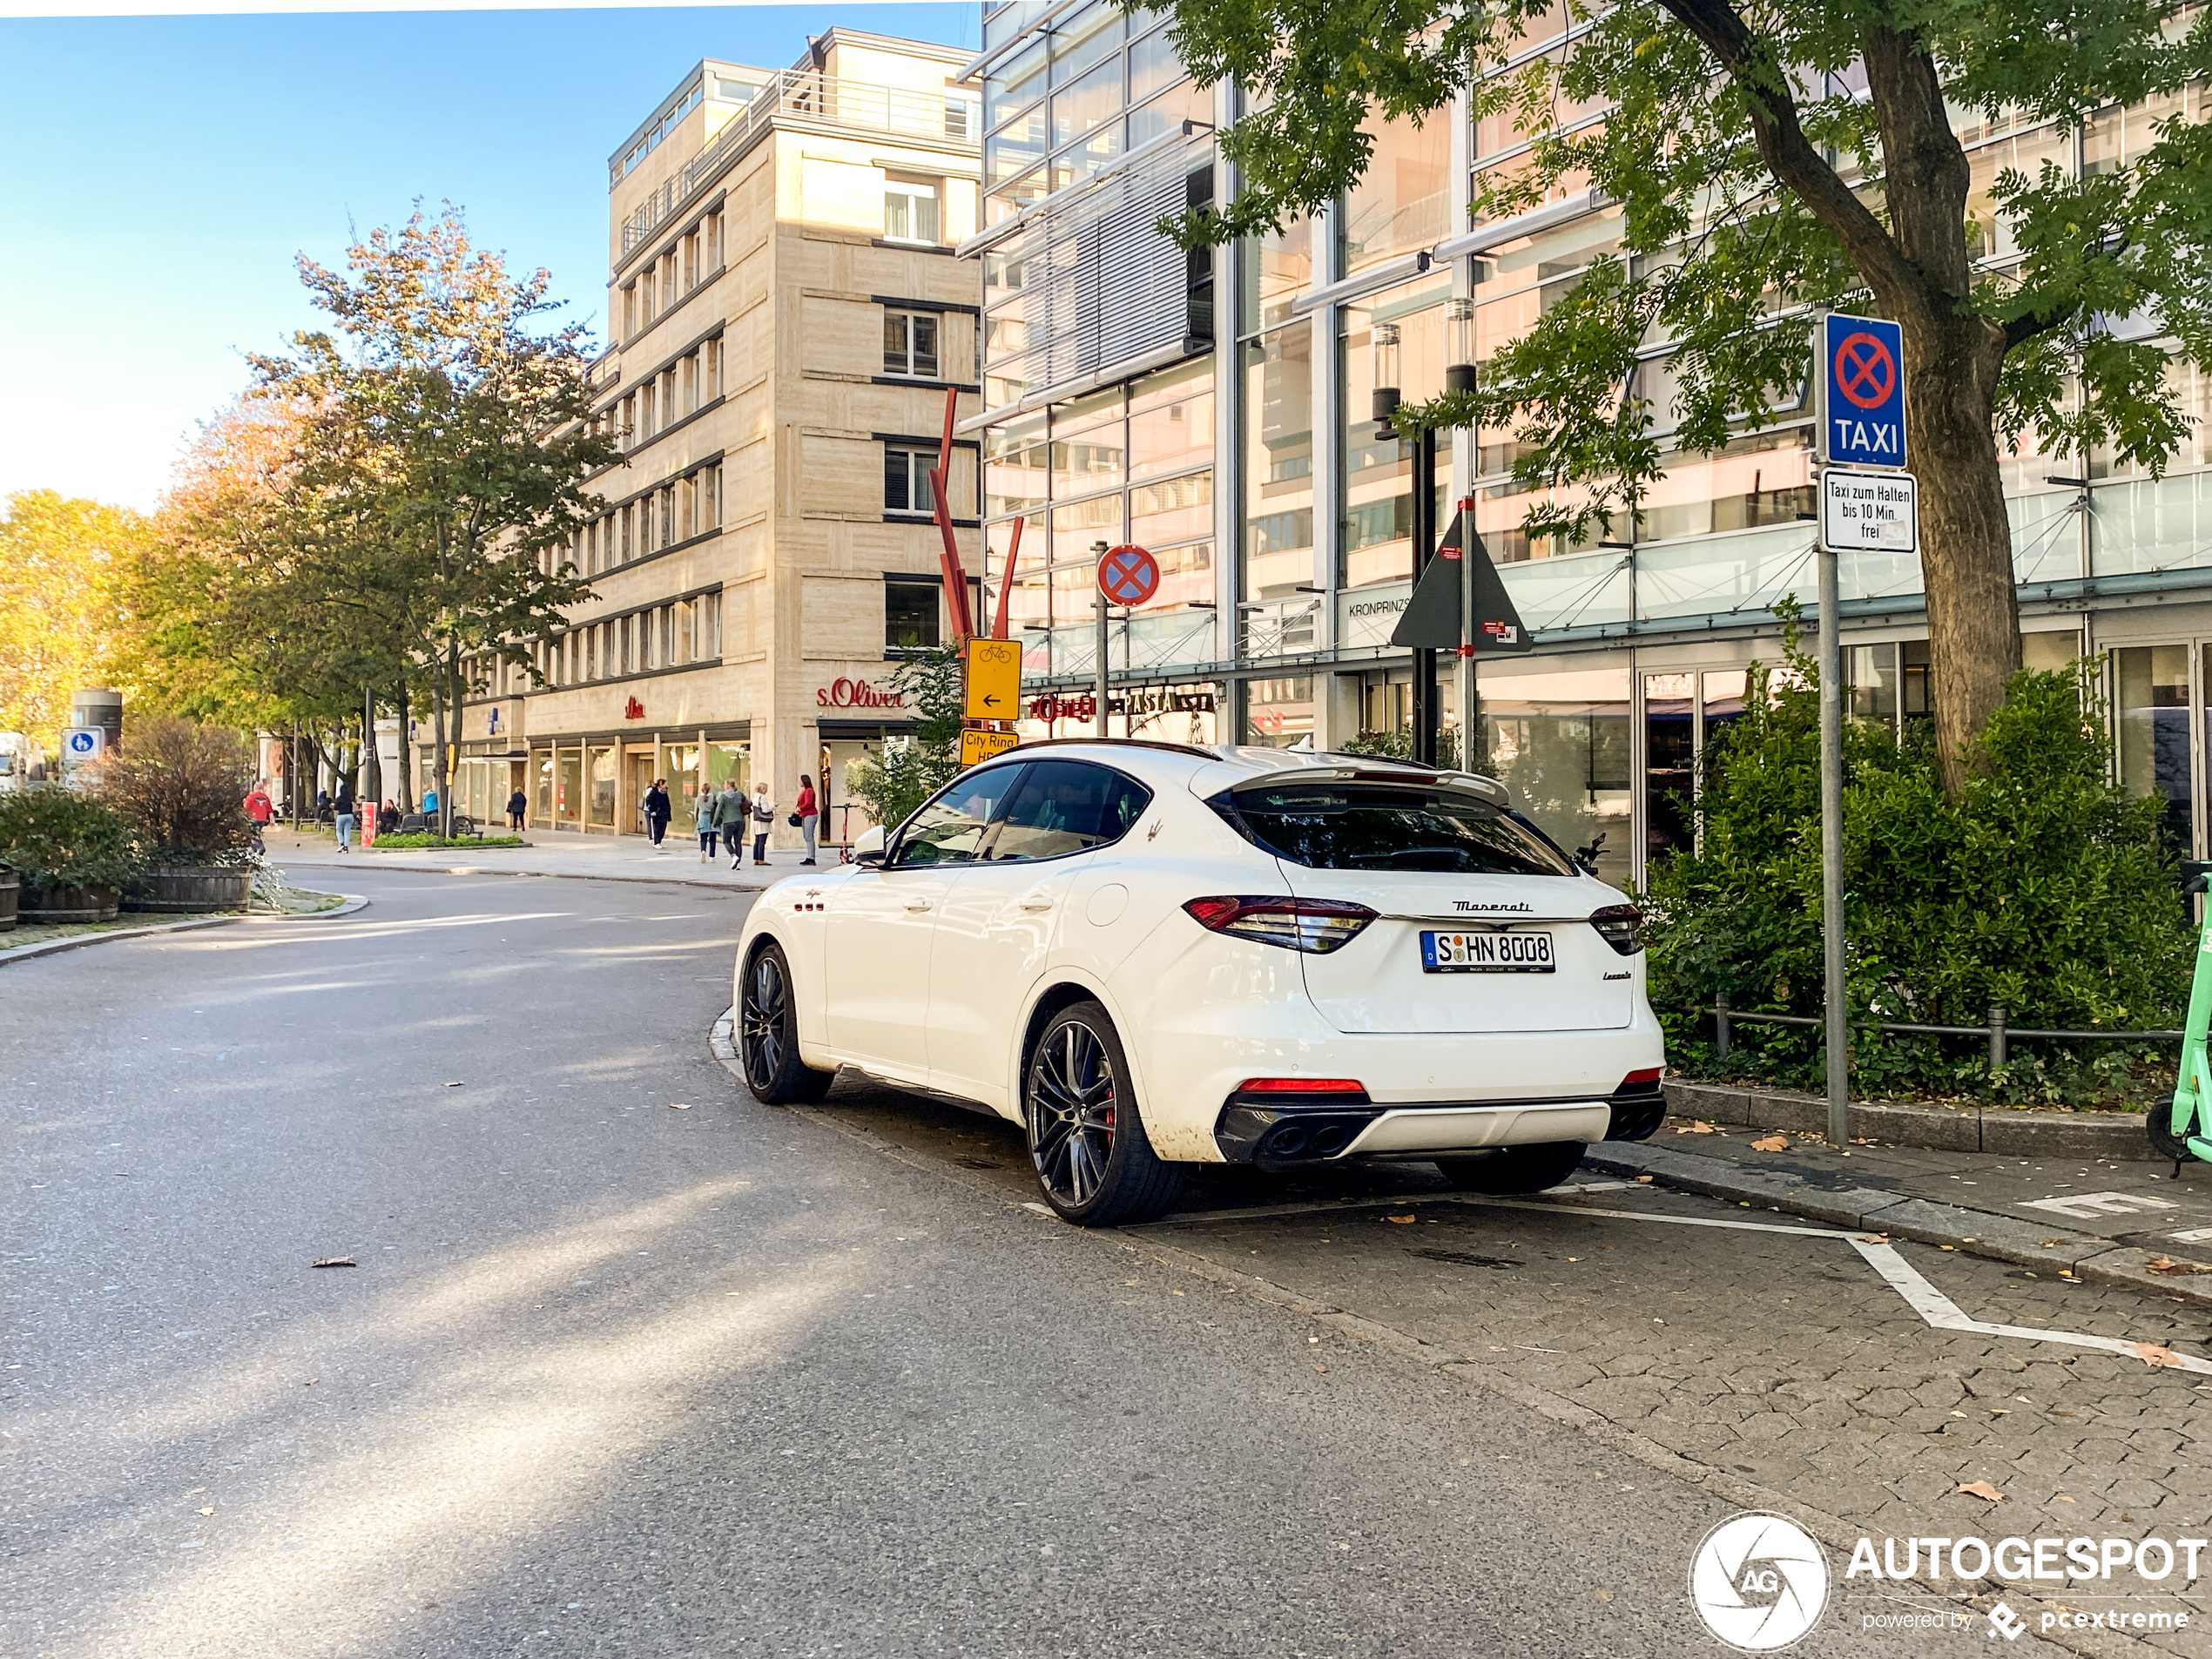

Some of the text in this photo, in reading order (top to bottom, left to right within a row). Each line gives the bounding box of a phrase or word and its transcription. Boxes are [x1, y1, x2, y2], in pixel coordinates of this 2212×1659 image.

[1835, 419, 1898, 454] TAXI
[1830, 482, 1910, 502] Taxi zum Halten
[1843, 502, 1898, 521] bis 10 Min.
[1861, 523, 1879, 538] frei
[816, 676, 905, 708] s.Oliver
[1124, 693, 1172, 712] PASTA
[967, 734, 986, 748] City
[1453, 900, 1534, 912] Maserati
[1438, 936, 1549, 962] S HN 8008
